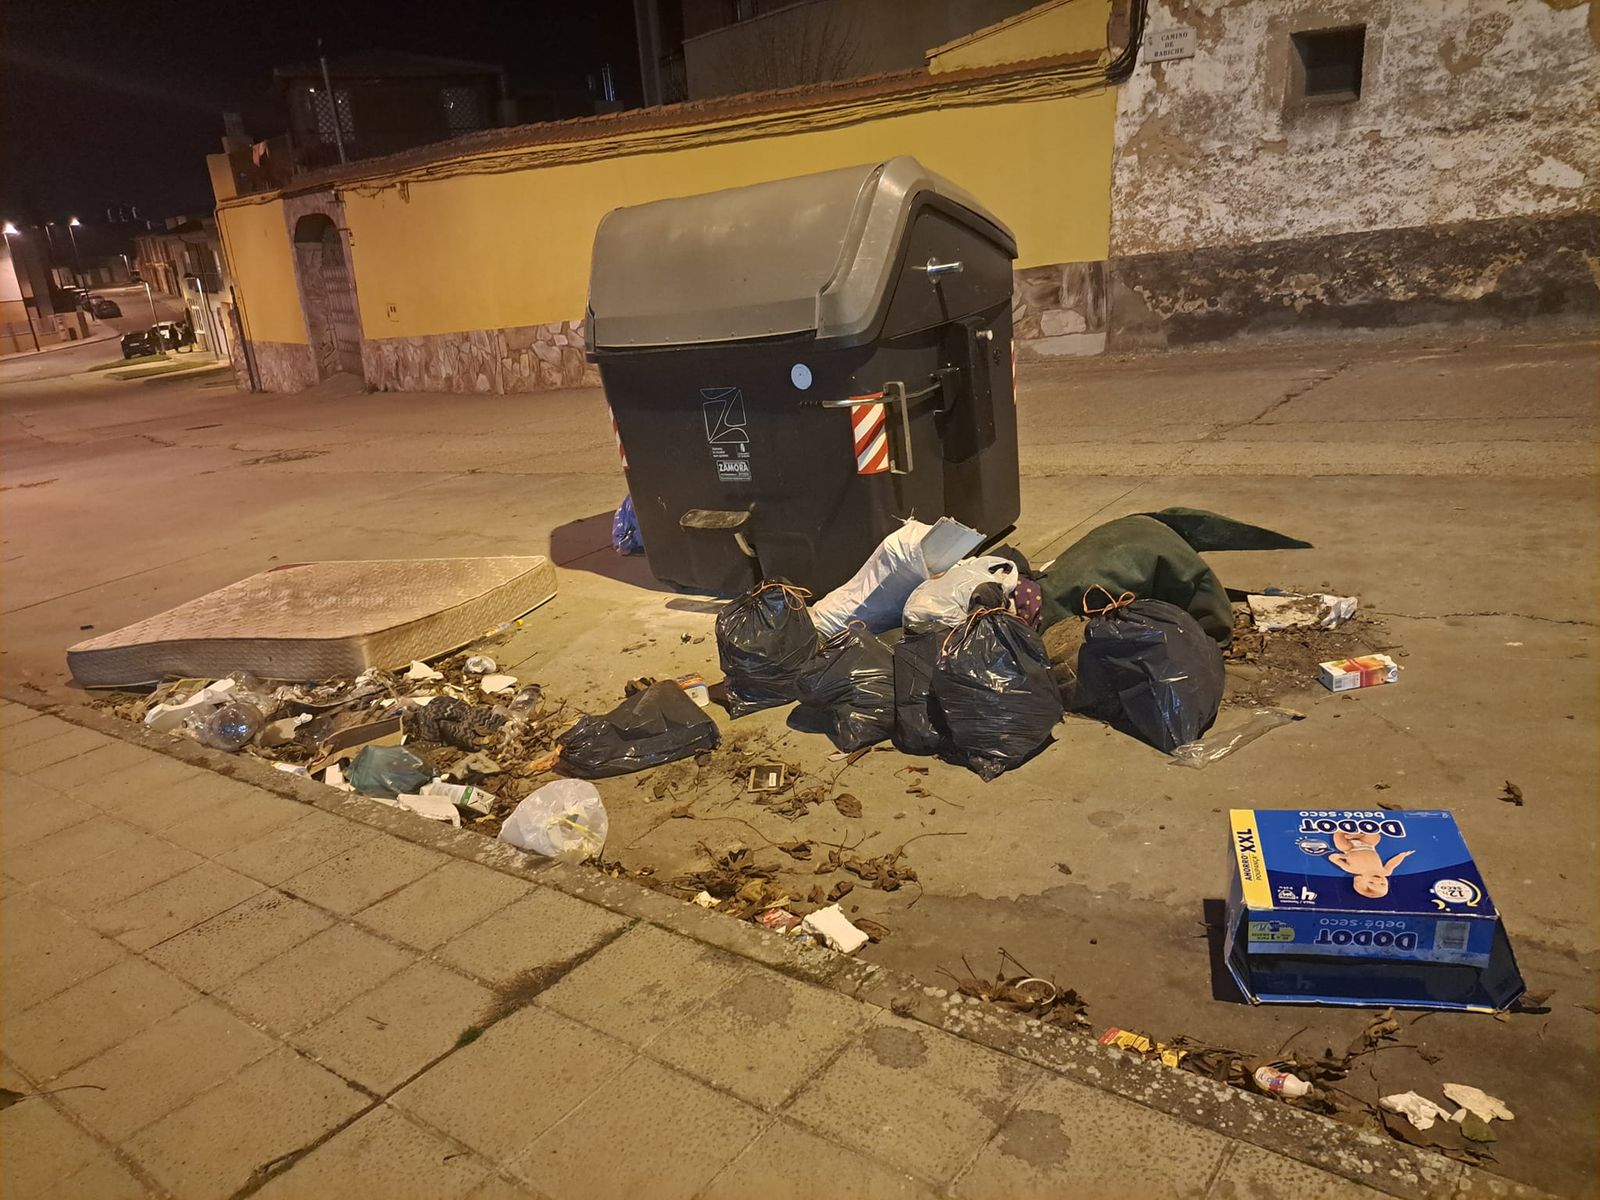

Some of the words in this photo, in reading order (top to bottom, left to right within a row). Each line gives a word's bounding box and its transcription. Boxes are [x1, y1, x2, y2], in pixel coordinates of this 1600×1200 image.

[1161, 32, 1188, 41] CAMINO
[719, 463, 749, 472] ZAMORA
[1299, 819, 1406, 837] DODOT
[1236, 828, 1256, 853] XXL
[1241, 855, 1253, 881] AHORRO
[1301, 886, 1317, 900] 4
[1313, 928, 1418, 952] DODOT
